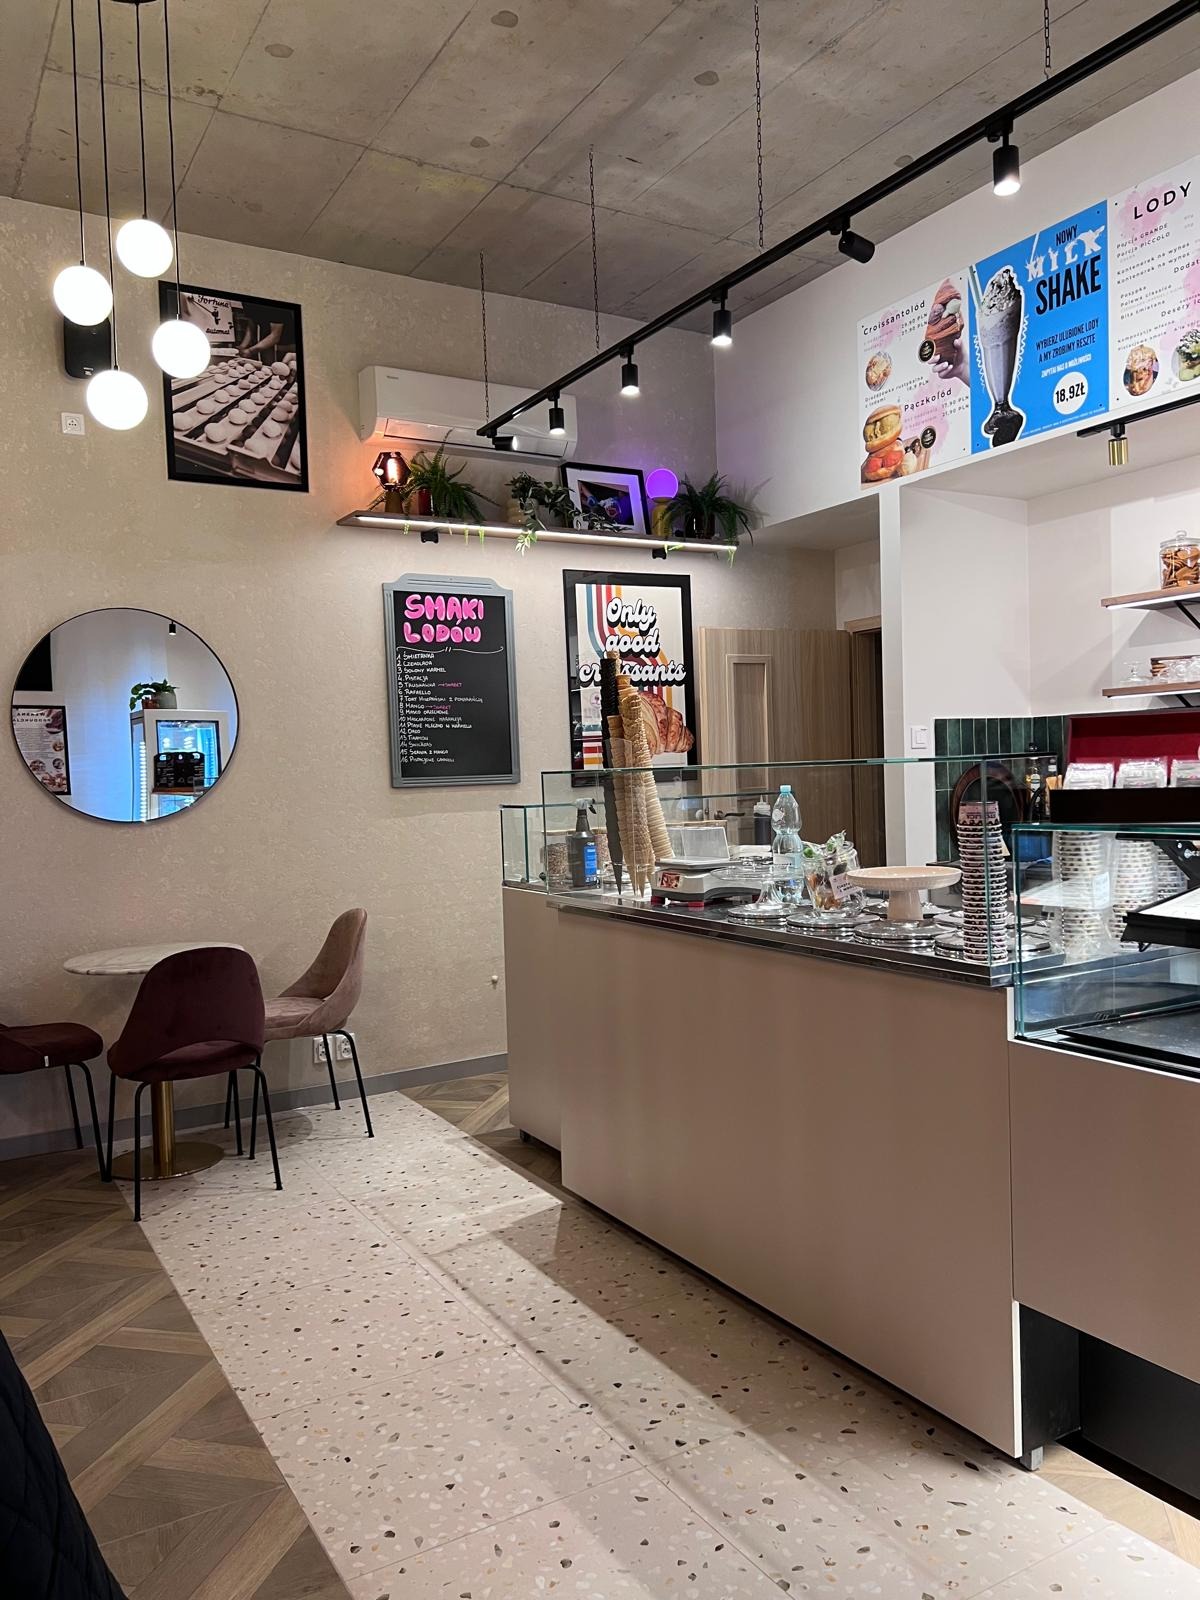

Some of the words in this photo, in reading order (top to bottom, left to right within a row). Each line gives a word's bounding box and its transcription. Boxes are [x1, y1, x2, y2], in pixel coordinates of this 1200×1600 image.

[1133, 181, 1192, 220] LODY
[1056, 224, 1078, 246] NOWY
[1140, 223, 1168, 239] GRANDE
[1140, 232, 1170, 248] PICCOLO
[1036, 254, 1102, 315] SHAKE
[1036, 334, 1058, 351] WYBIERZ
[1059, 324, 1084, 344] ULUBIONE
[1085, 318, 1099, 332] LODY
[1039, 353, 1043, 363] A
[1043, 350, 1052, 362] MY
[1052, 341, 1075, 359] ZROBIMY
[404, 594, 484, 620] SMAKI
[606, 597, 657, 636] Only
[403, 619, 481, 643] LODÓW
[605, 628, 660, 658] good
[579, 660, 686, 688] crssants
